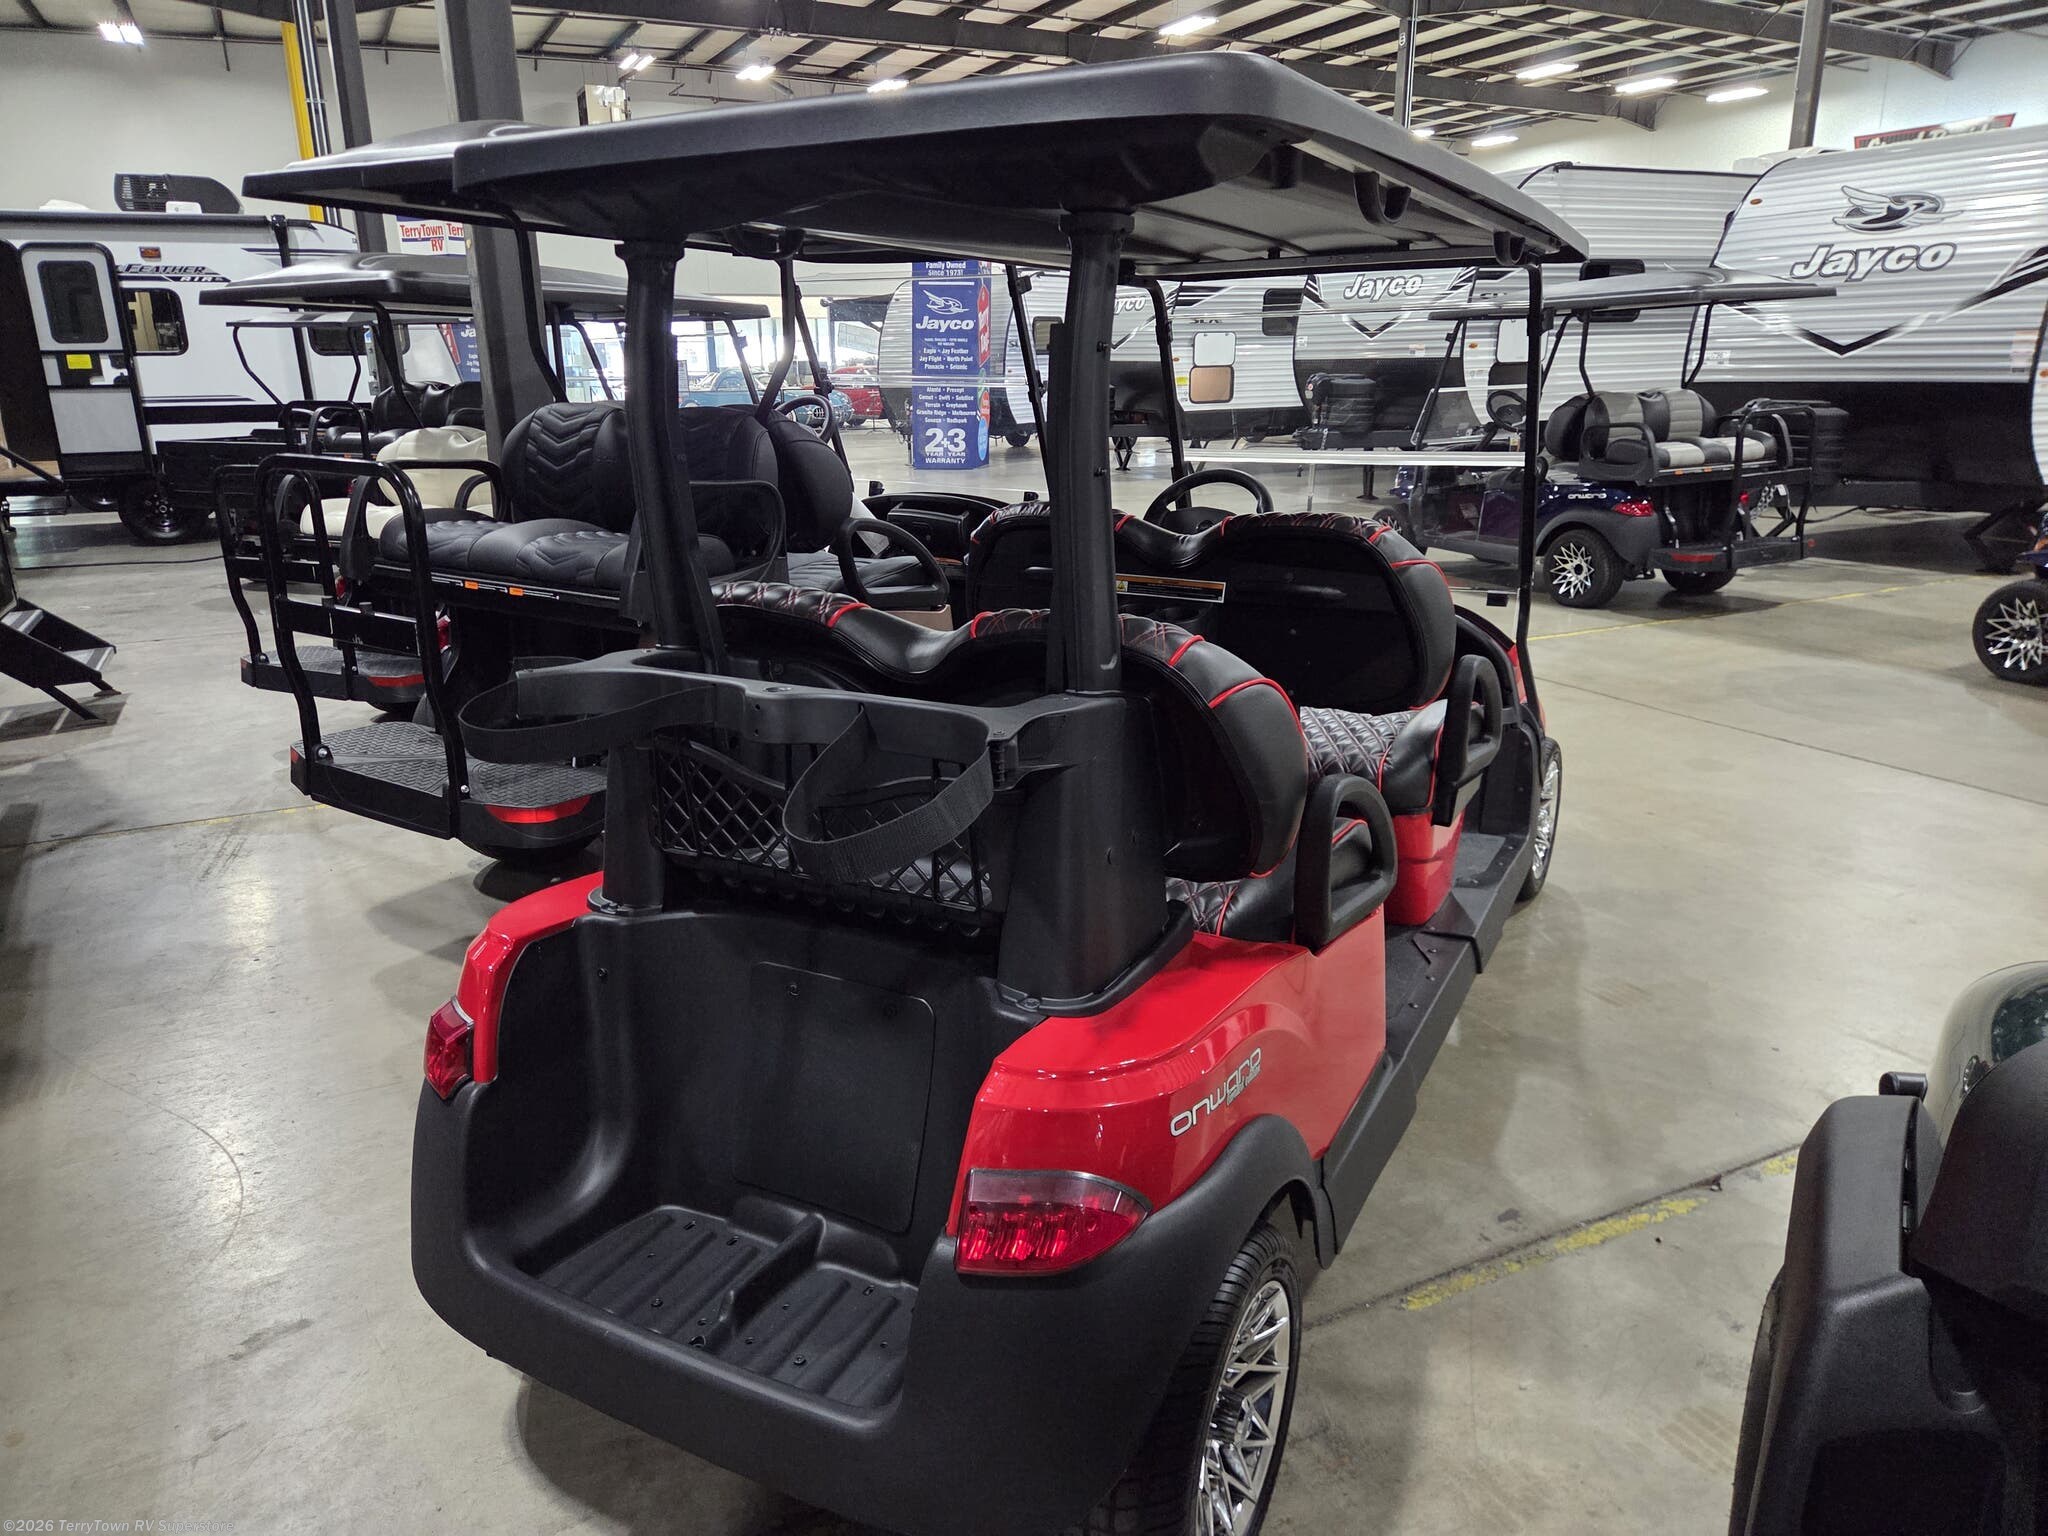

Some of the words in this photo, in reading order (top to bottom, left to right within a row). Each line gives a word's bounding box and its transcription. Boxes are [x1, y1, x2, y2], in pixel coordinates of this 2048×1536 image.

[400, 224, 443, 240] TerryTown
[430, 239, 443, 252] RV
[925, 261, 945, 270] Family
[945, 261, 966, 269] Owned
[1790, 242, 1957, 283] Jayco
[1343, 273, 1424, 303] Jayco
[1114, 295, 1147, 315] yco
[915, 315, 975, 333] Jayco
